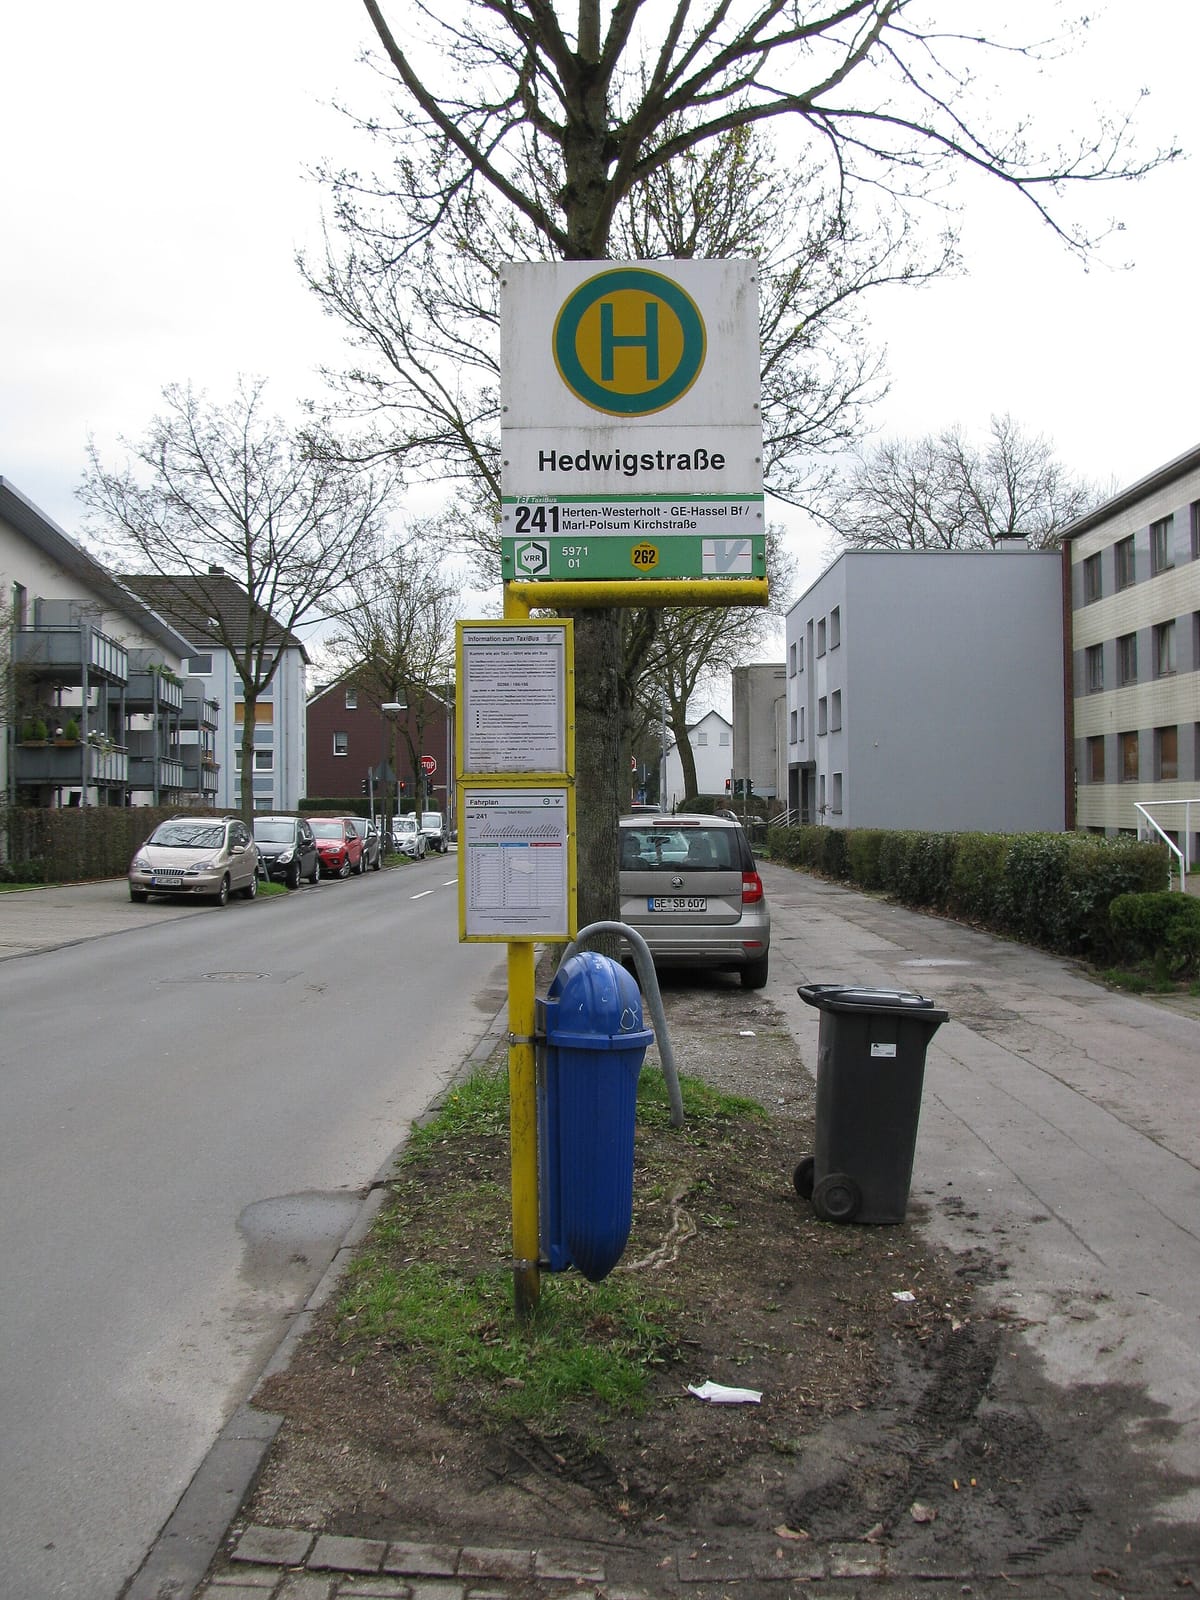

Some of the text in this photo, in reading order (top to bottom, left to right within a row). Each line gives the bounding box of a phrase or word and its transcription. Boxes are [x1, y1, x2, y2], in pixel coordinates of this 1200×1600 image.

[600, 303, 659, 381] H
[538, 449, 726, 477] Hedwigstraße
[562, 507, 661, 517] Herten-Westerholt
[670, 506, 727, 517] GE-Hassel
[731, 506, 743, 516] Bf
[744, 506, 750, 516] /
[515, 506, 559, 533] 241
[562, 519, 697, 530] Marl-Polsum Kirchstraße
[562, 547, 588, 556] 5971
[634, 549, 656, 564] 262
[568, 559, 580, 568] 01
[654, 898, 705, 908] GE SB 607
